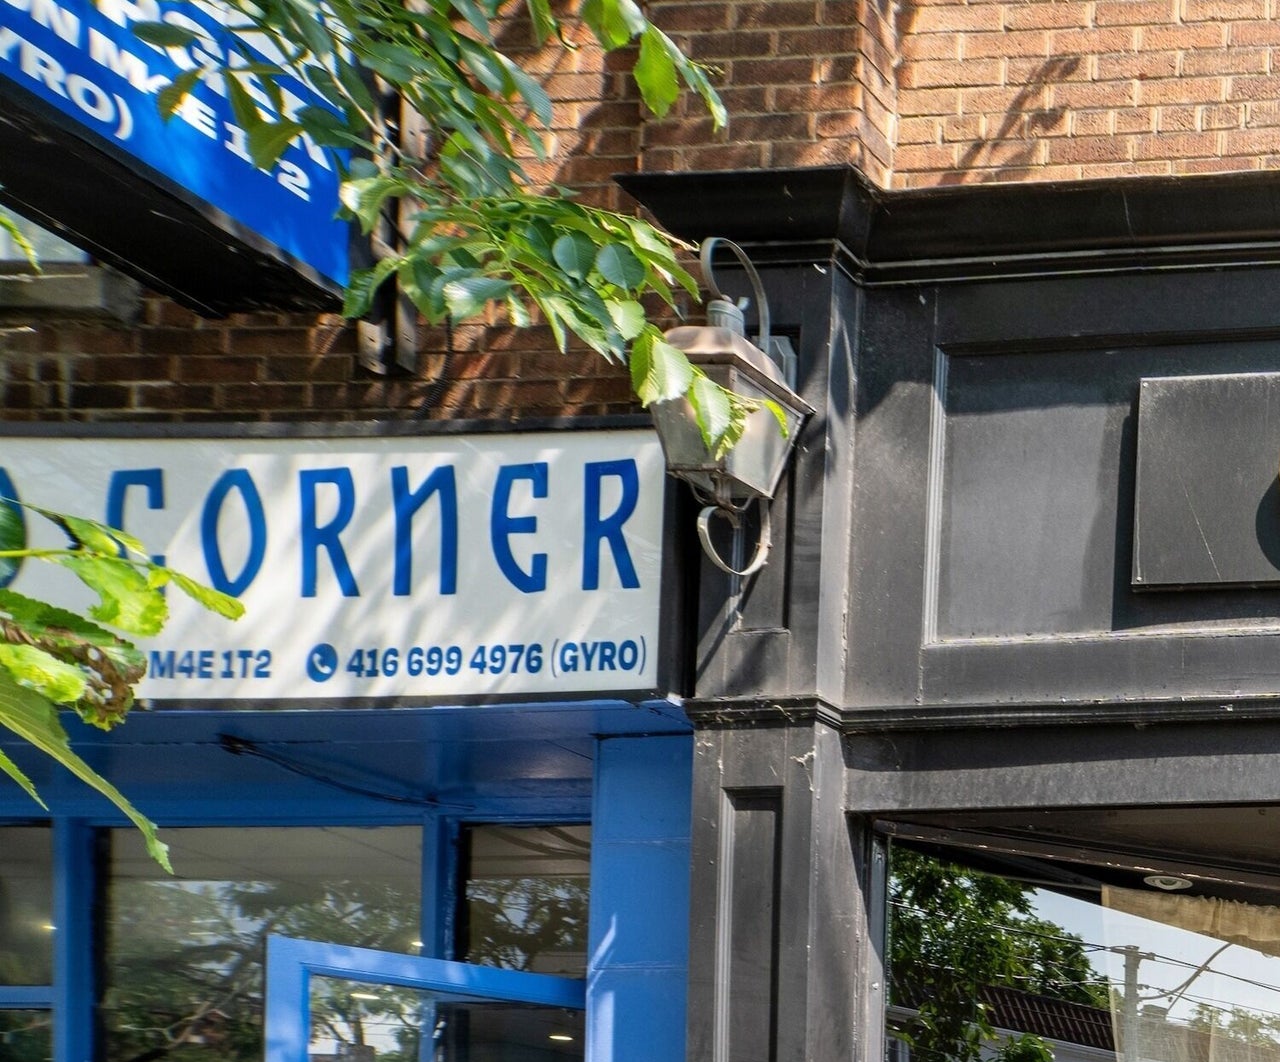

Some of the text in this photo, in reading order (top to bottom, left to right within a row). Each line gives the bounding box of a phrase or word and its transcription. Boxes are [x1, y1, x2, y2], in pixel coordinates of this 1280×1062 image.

[106, 458, 641, 599] CORNER
[151, 635, 647, 680] M4E 1T2 416 699 4976 (GYRO)
